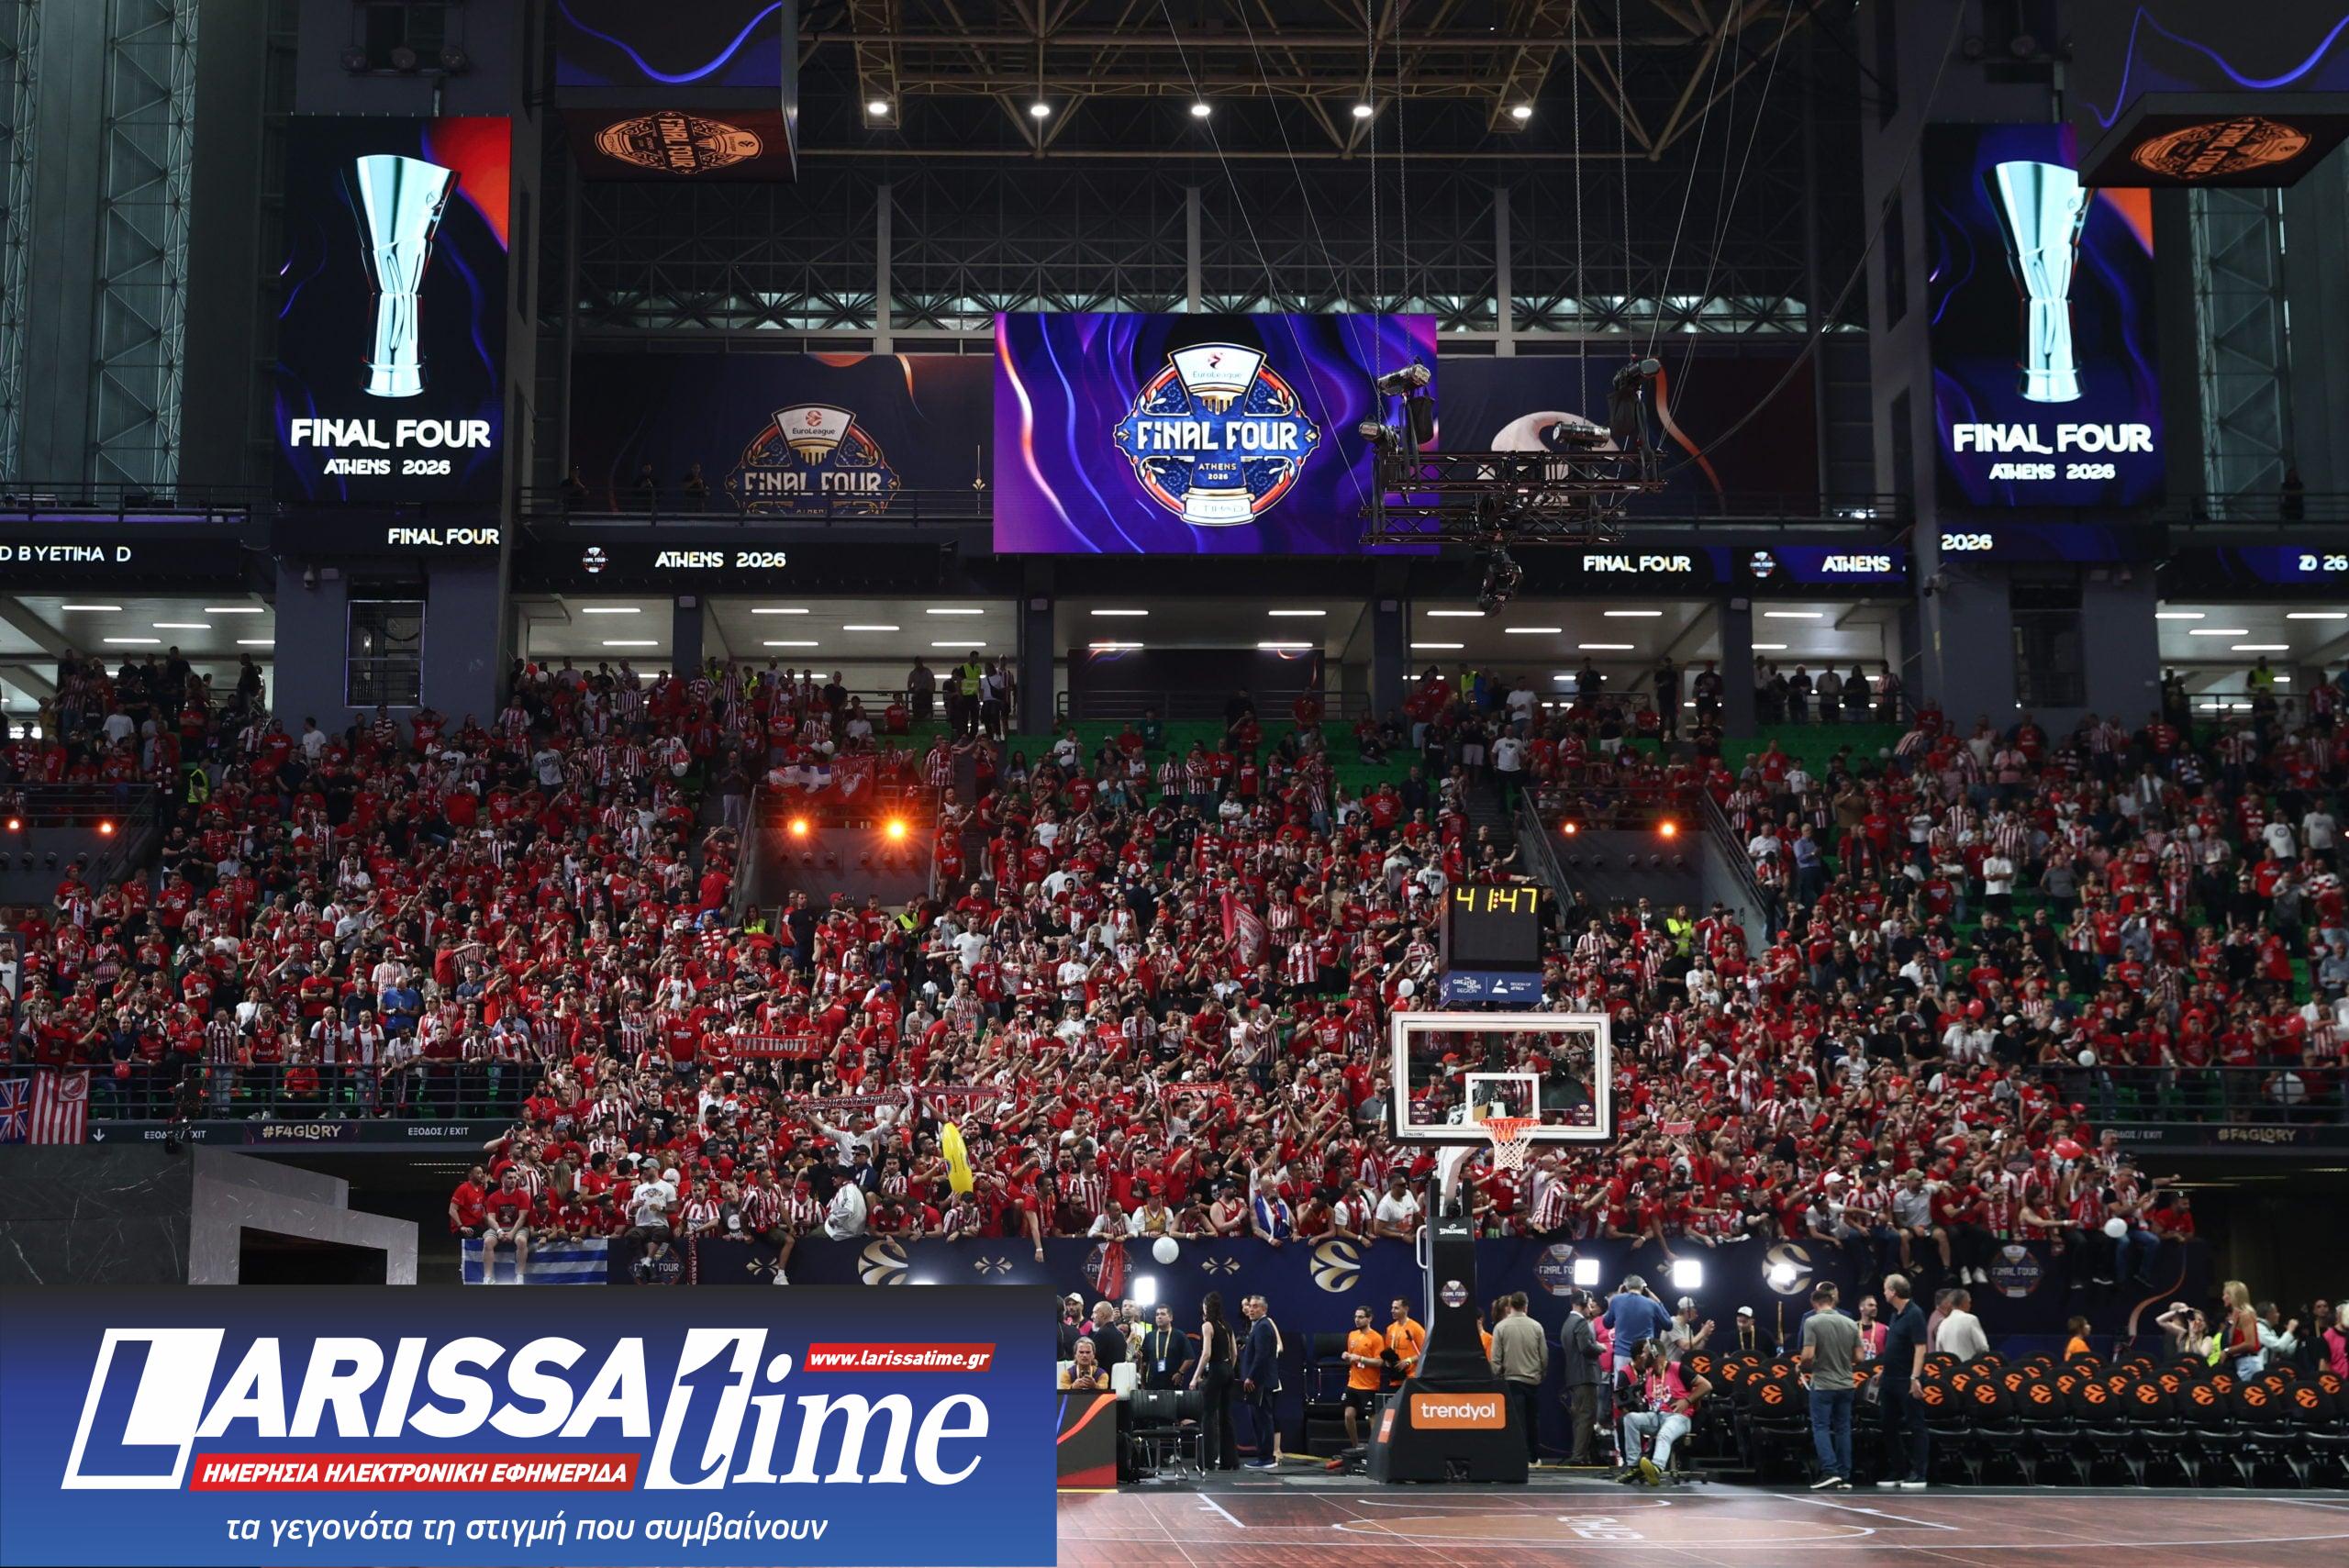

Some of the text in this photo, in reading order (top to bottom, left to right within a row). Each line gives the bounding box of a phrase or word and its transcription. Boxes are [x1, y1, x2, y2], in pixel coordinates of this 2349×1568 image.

[291, 418, 491, 450] FINAL FOUR
[792, 428, 836, 437] EuroLeague
[1226, 421, 1299, 450] FOUR
[1953, 423, 2154, 455] FINAL FOUR
[324, 459, 451, 475] ATHENS 2026
[1197, 462, 1237, 472] ATHENS
[1988, 462, 2117, 481] ATHENS 2026
[1208, 473, 1229, 481] 2026
[388, 528, 500, 546] FINAL FOUR
[1941, 533, 1994, 551] 2026
[654, 550, 787, 568] ATHENS 2026
[1583, 554, 1692, 573] FINAL FOUR
[1821, 554, 1892, 573] ATHENS
[1455, 886, 1538, 914] 41:47
[191, 1129, 206, 1139] XIT
[262, 1124, 341, 1140] #F4GLORY
[407, 1127, 442, 1137] ΕΞΟΔΟΣ
[449, 1127, 469, 1137] EXIT
[2218, 1128, 2296, 1143] #F4GLORY
[659, 1262, 679, 1273] FOUR
[1420, 1402, 1496, 1421] trendyol
